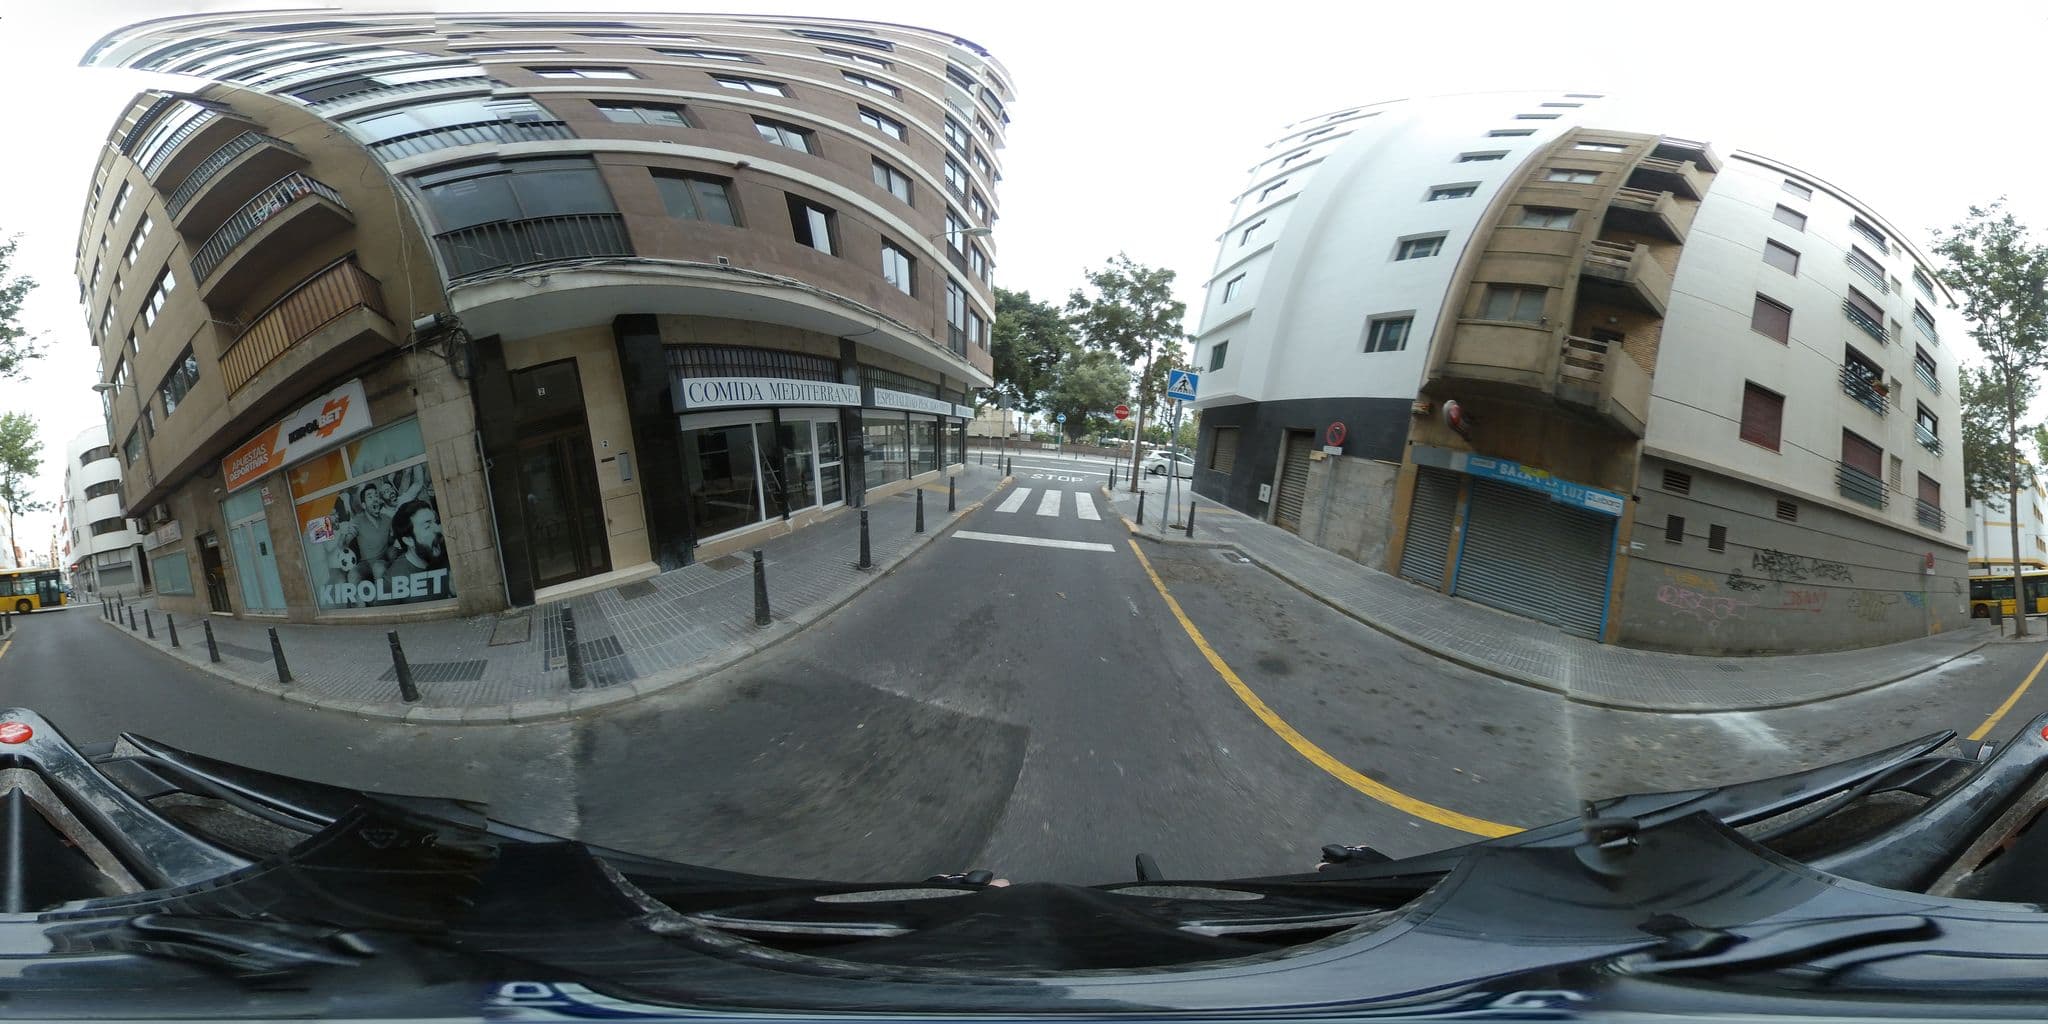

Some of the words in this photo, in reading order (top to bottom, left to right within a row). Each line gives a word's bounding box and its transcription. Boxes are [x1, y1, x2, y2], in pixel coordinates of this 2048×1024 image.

[688, 381, 764, 403] COMIDA
[770, 382, 860, 404] MEDITERRANEA
[288, 406, 344, 445] KIROLBET
[229, 453, 269, 482] DEPORTIVAS
[232, 444, 266, 471] APUESTAS
[1030, 473, 1083, 482] STOP
[1562, 484, 1585, 500] LUZ
[320, 567, 448, 604] KIROLBET
